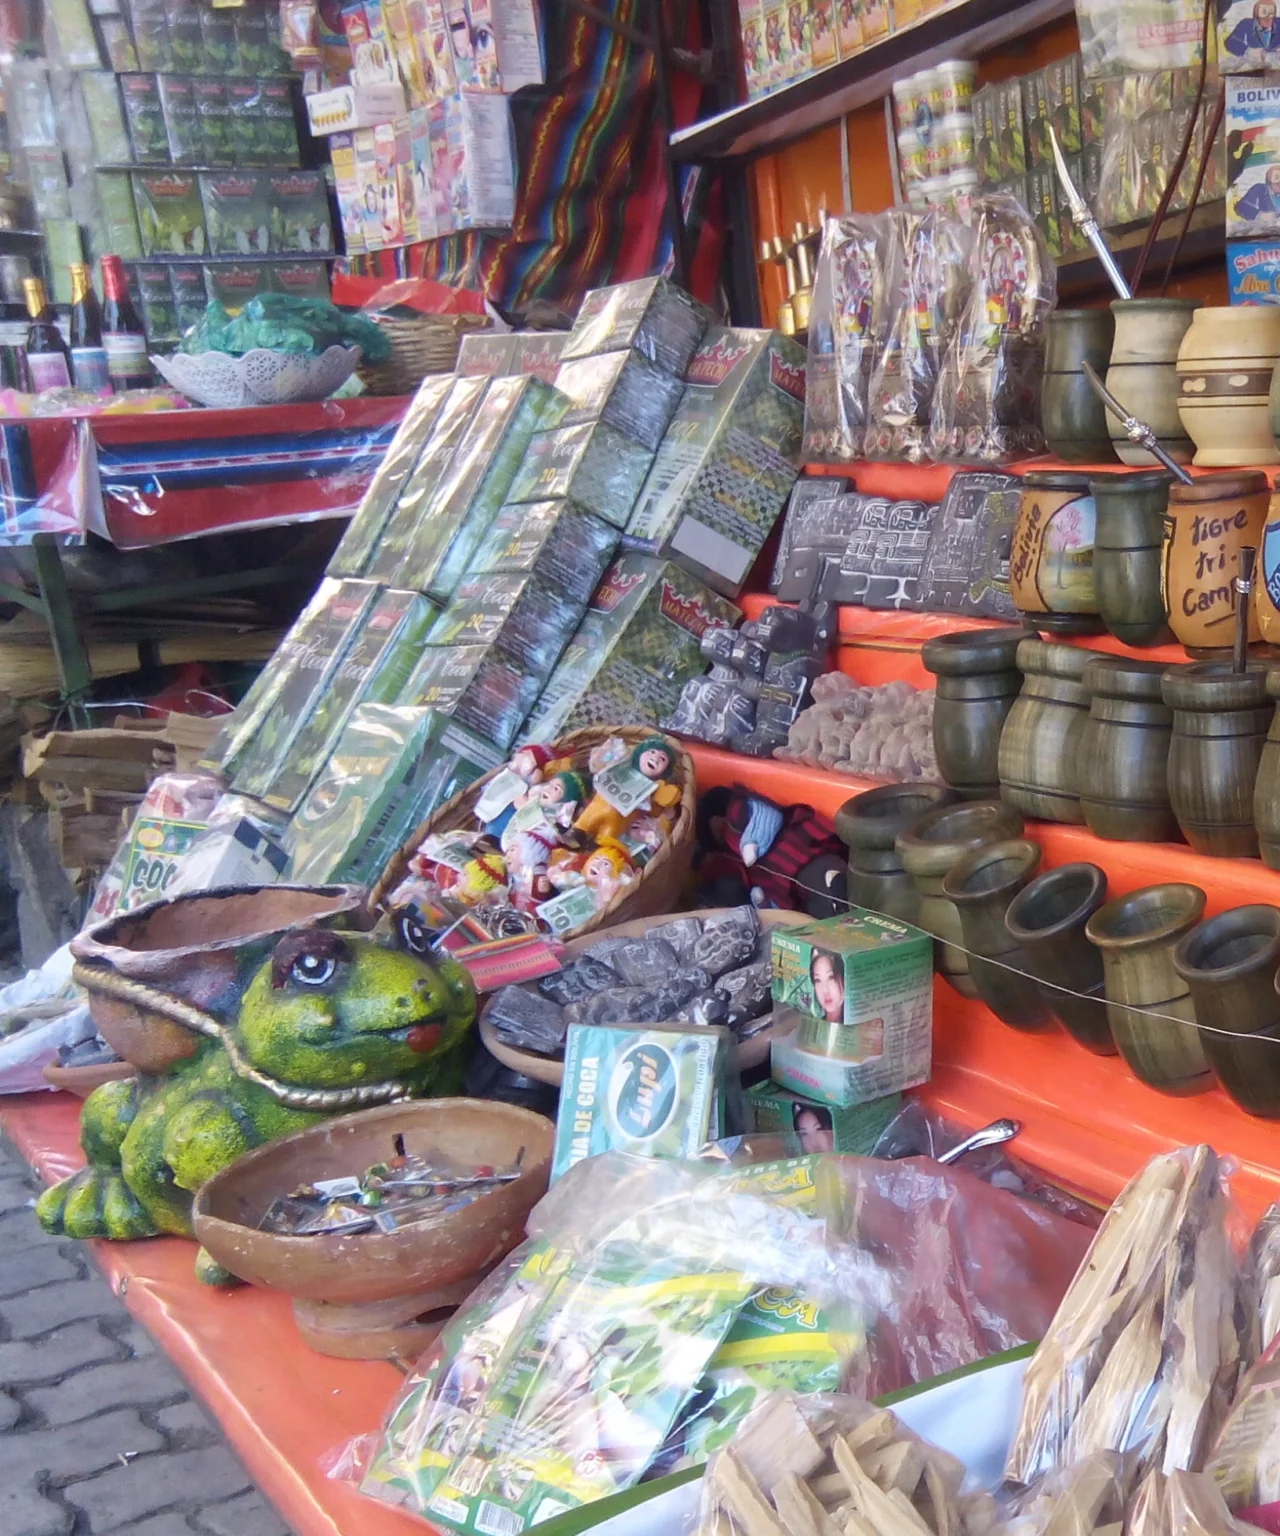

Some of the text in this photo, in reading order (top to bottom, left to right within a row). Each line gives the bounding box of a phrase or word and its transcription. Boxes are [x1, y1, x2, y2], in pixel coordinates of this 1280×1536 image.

[602, 774, 632, 804] 100
[550, 906, 571, 930] 10
[864, 915, 908, 934] CREMA
[772, 937, 800, 953] CREMA
[577, 1056, 599, 1107] COCA
[629, 1053, 662, 1128] Lupi
[574, 1110, 593, 1132] DE
